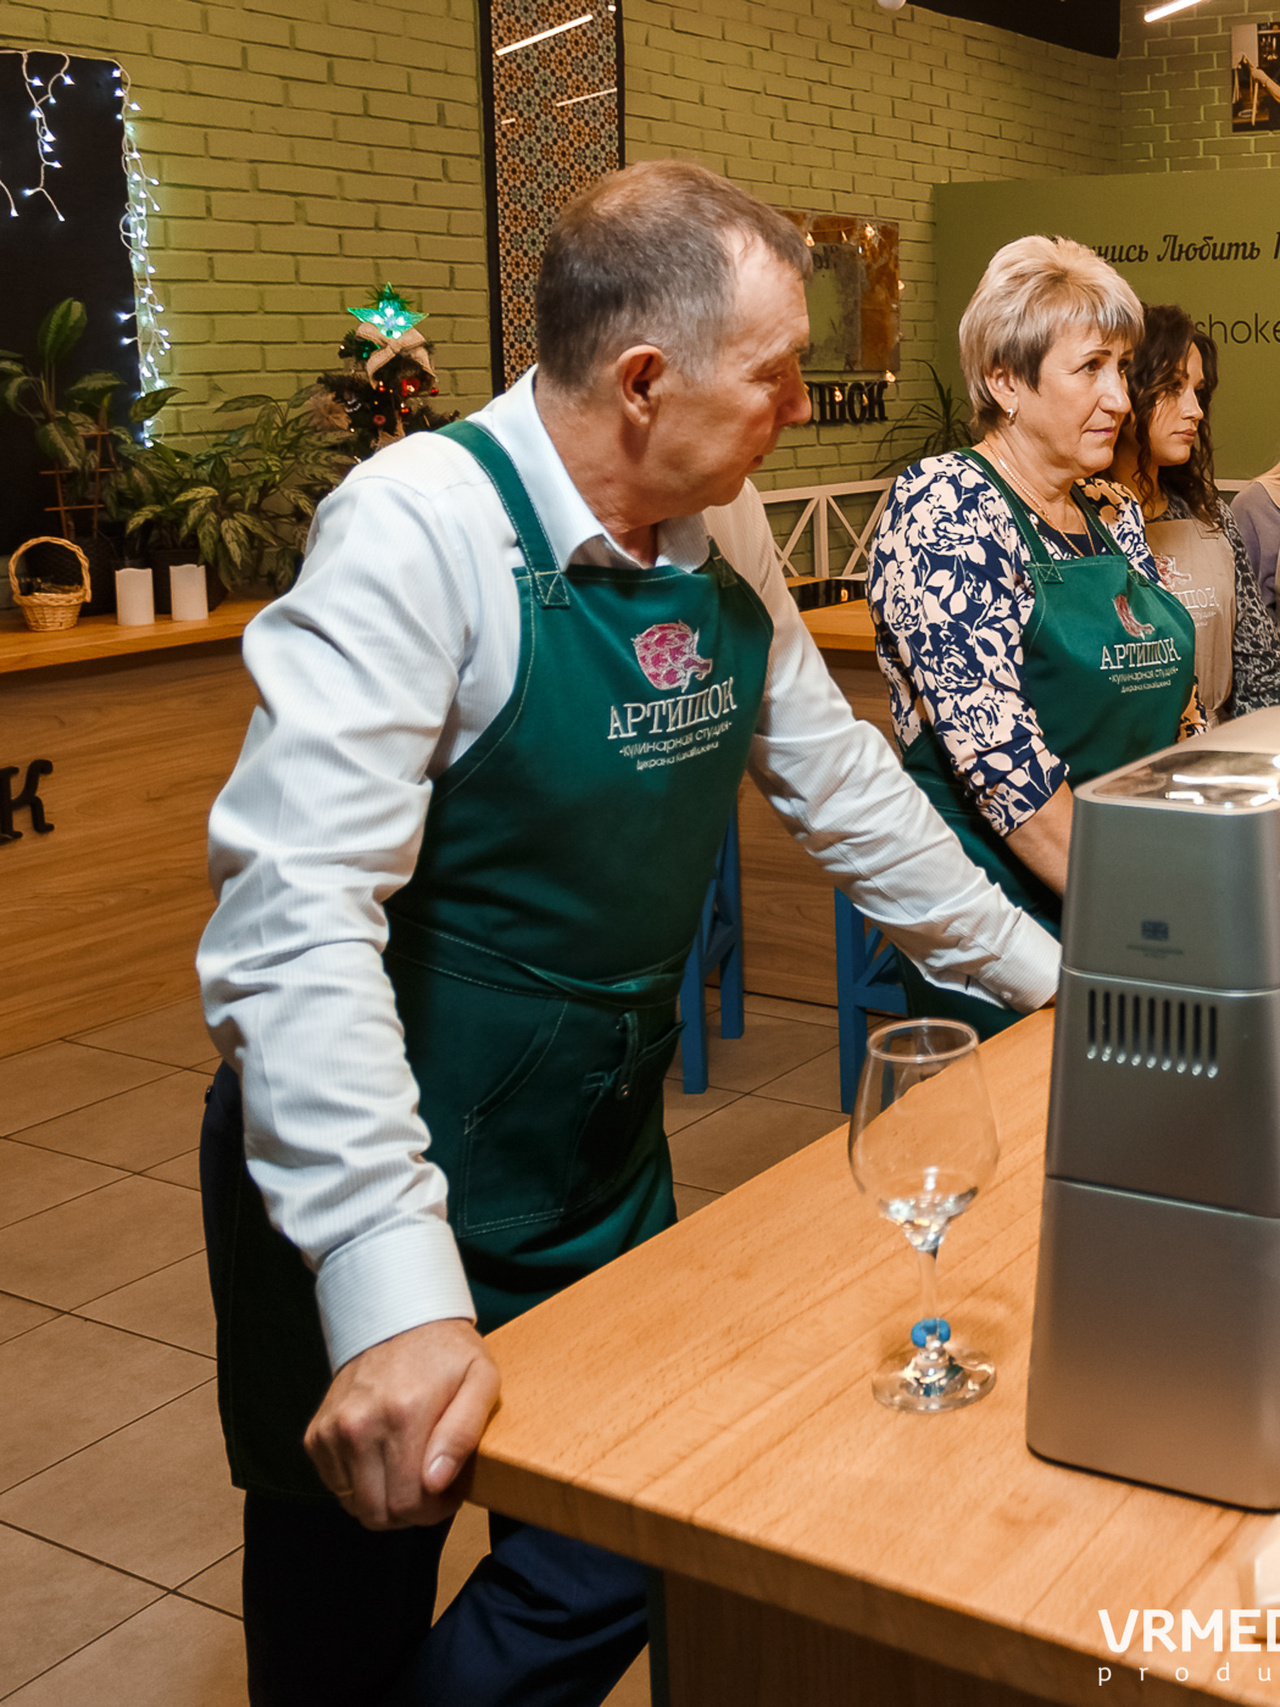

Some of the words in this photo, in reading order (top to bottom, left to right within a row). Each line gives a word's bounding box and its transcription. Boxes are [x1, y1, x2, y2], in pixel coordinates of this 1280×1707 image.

[1092, 244, 1149, 263] чись
[1156, 233, 1261, 262] Любить
[1100, 637, 1182, 670] АРТИШОК
[607, 677, 738, 740] АРТИШОК
